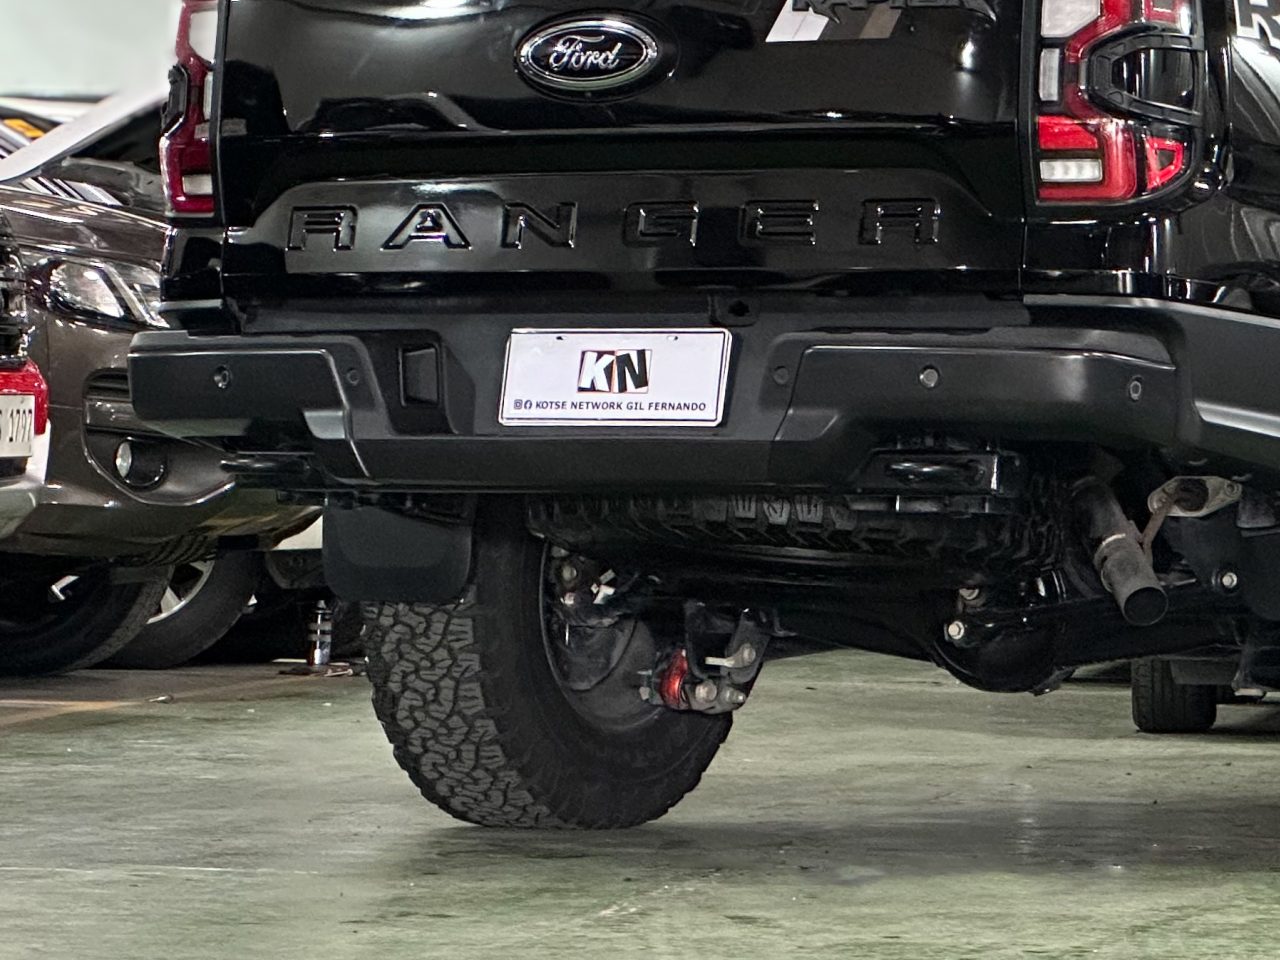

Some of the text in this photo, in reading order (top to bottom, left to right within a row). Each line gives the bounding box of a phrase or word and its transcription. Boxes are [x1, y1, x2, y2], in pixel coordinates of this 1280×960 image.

[550, 34, 623, 71] Ford
[286, 199, 940, 251] RANGER
[577, 349, 651, 394] KN
[535, 400, 707, 412] KOTSE NETWORK GIL FERNANDO
